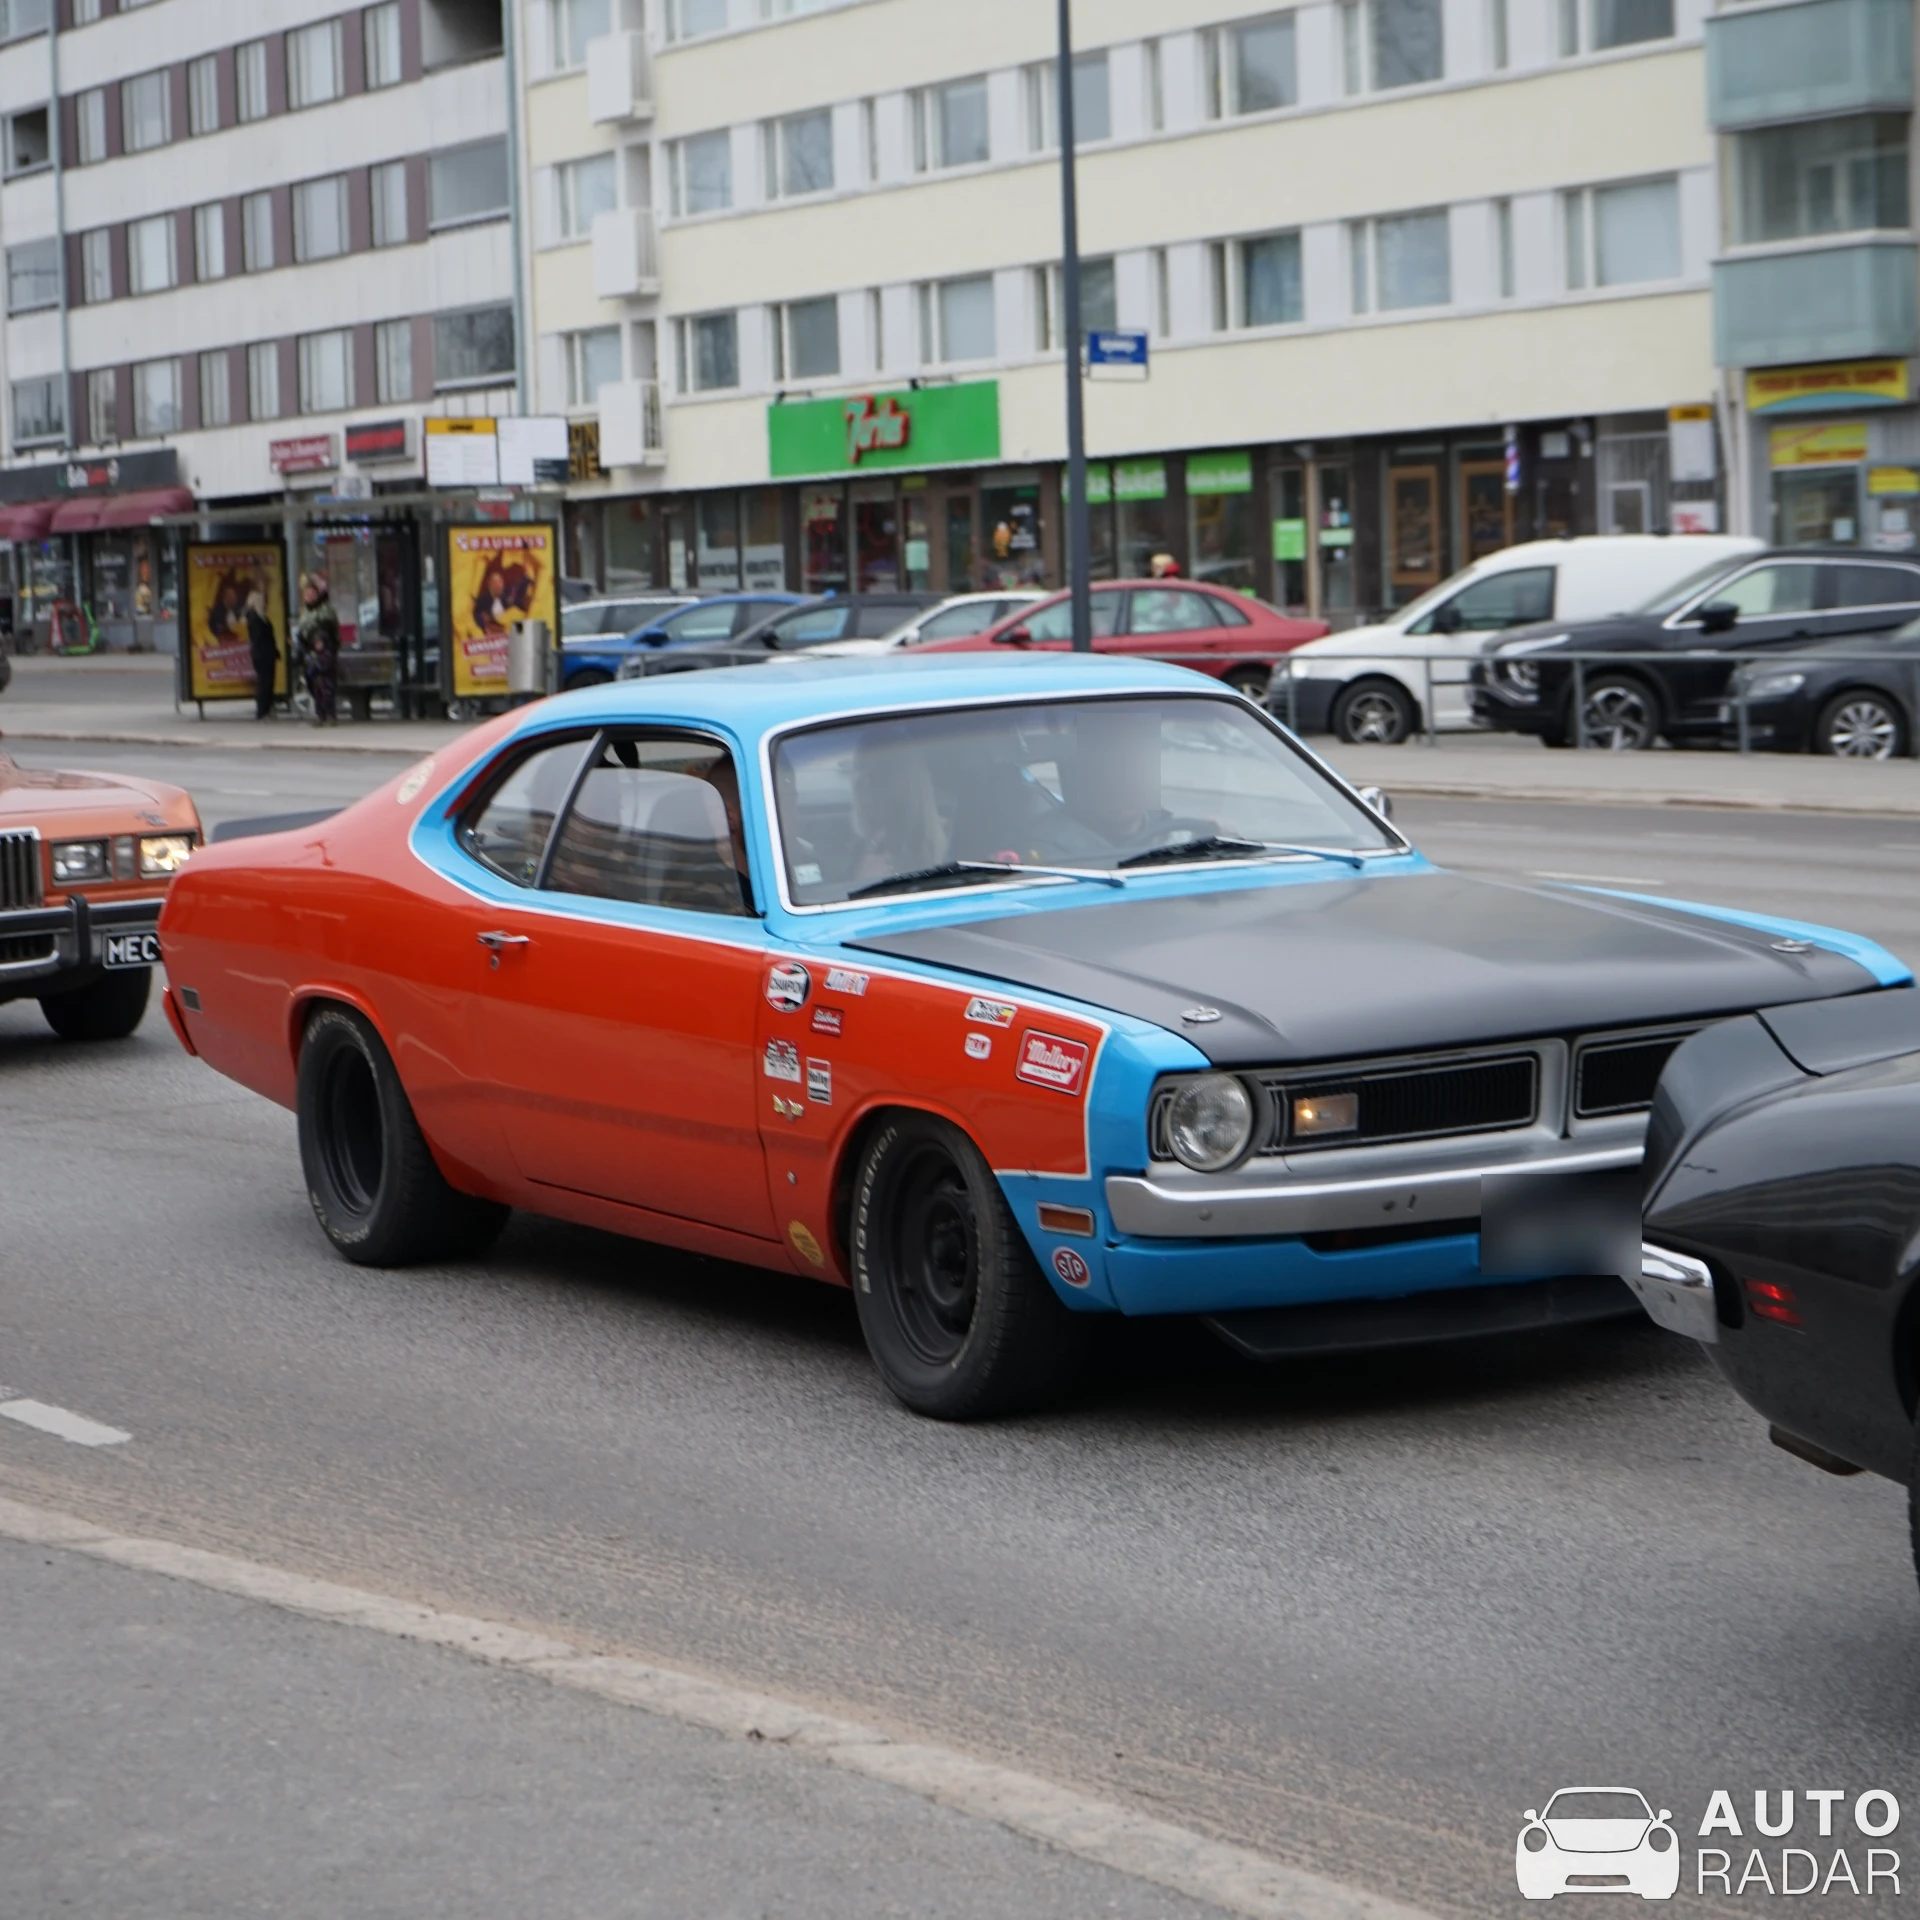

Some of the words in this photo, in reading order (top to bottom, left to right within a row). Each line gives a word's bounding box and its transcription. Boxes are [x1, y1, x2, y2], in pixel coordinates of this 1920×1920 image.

[470, 535, 545, 550] BAUHAUS
[1027, 1039, 1082, 1075] Mallory
[1057, 1253, 1083, 1280] STP
